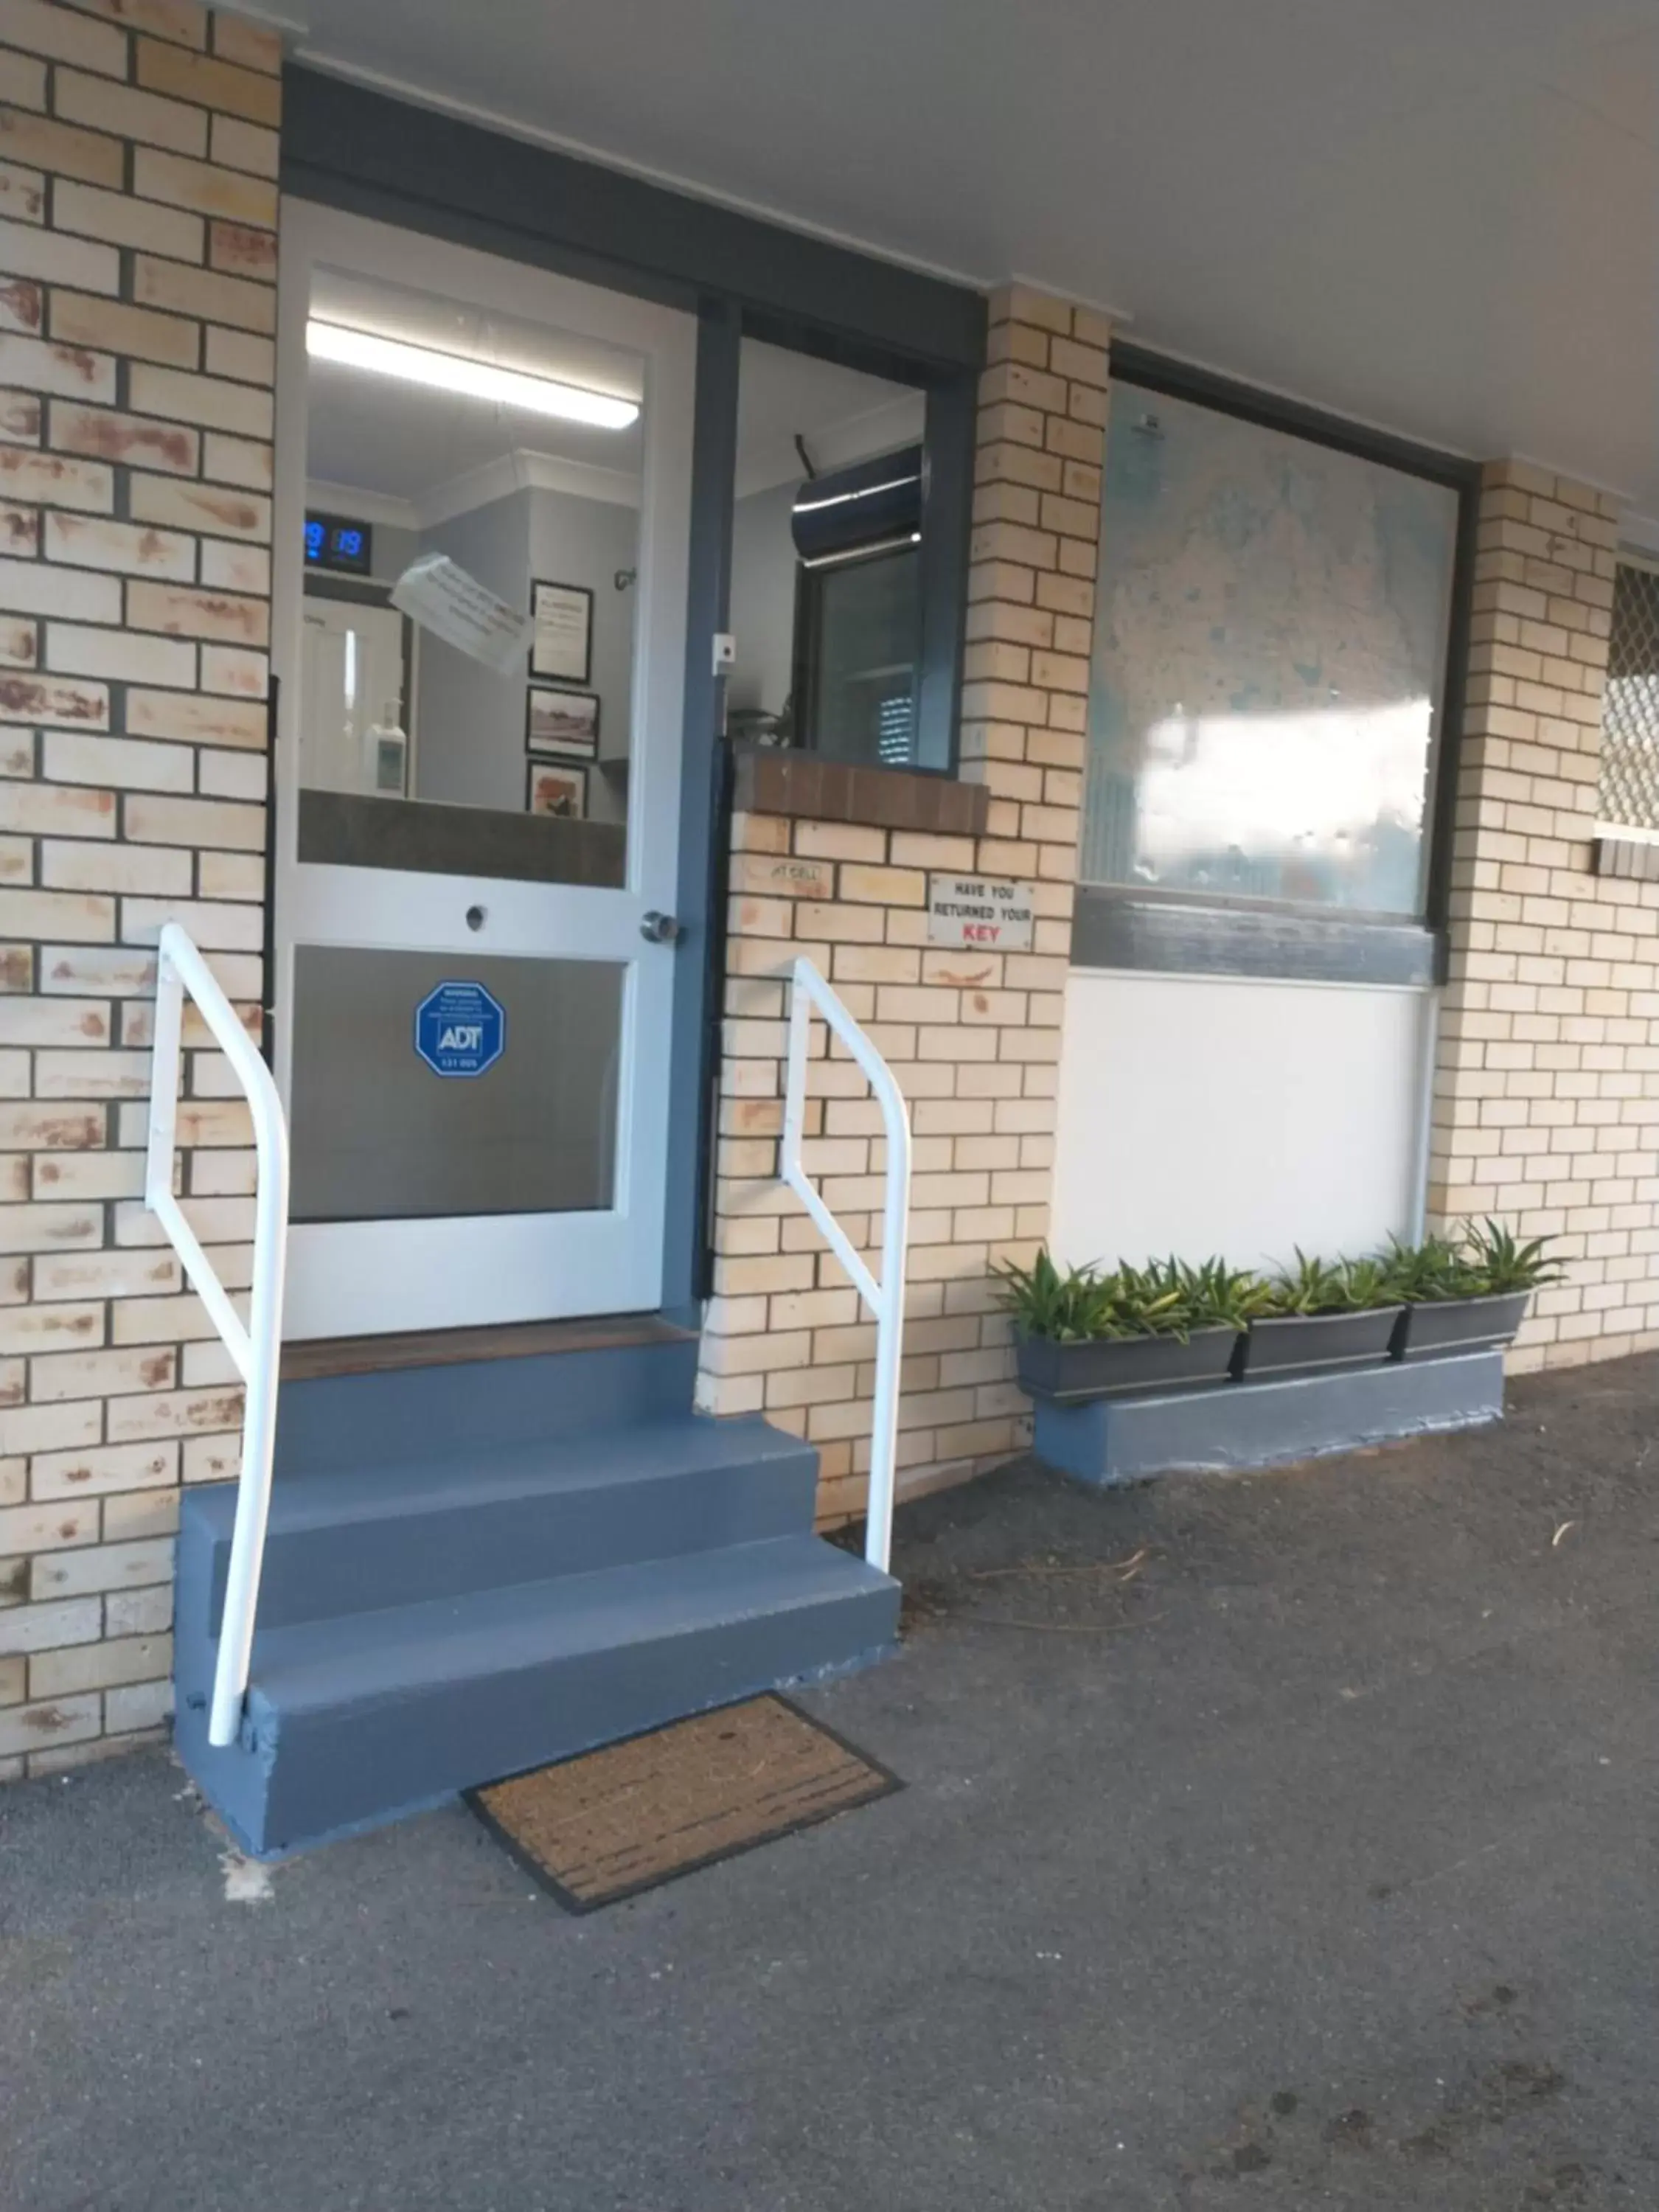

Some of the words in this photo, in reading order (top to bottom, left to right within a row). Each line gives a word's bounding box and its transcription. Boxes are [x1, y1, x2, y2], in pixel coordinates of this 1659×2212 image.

[955, 883, 985, 897] HAVE
[992, 886, 1015, 900] YOU
[934, 902, 995, 919] RETURNED
[1001, 908, 1031, 921] YOUR
[963, 923, 1002, 943] KEY
[439, 1026, 482, 1051] ADT
